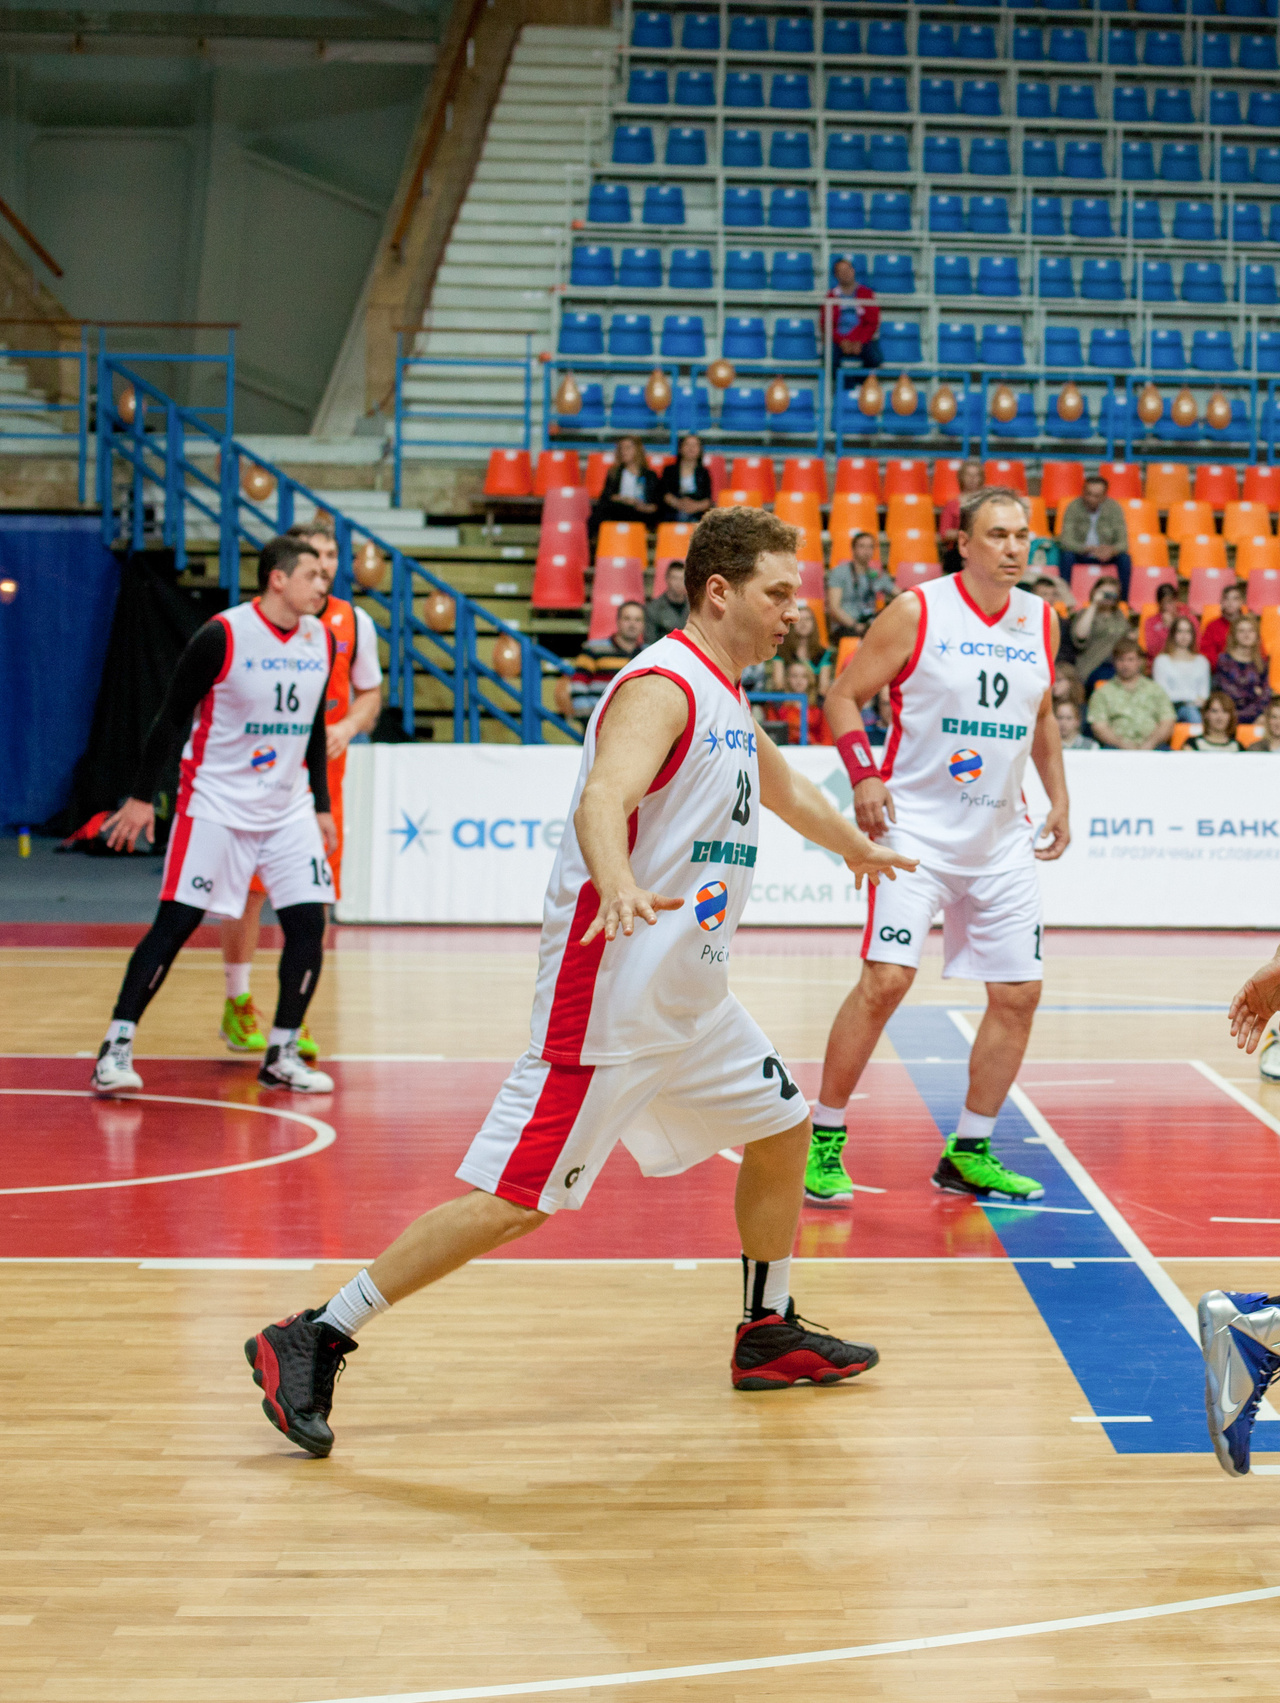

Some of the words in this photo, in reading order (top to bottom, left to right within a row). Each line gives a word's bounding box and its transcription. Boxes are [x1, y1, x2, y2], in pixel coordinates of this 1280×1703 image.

[960, 641, 1037, 664] астерос
[274, 682, 299, 712] 16
[978, 669, 1009, 709] 19
[942, 718, 1028, 741] СИБУР
[452, 818, 567, 849] асте
[1088, 817, 1154, 837] ДИЛ
[1197, 819, 1280, 837] БАНК
[191, 875, 214, 893] GQ
[749, 884, 834, 901] ССКАЯ
[879, 925, 912, 946] GQ
[1033, 923, 1042, 961] 1
[762, 1055, 800, 1101] 2
